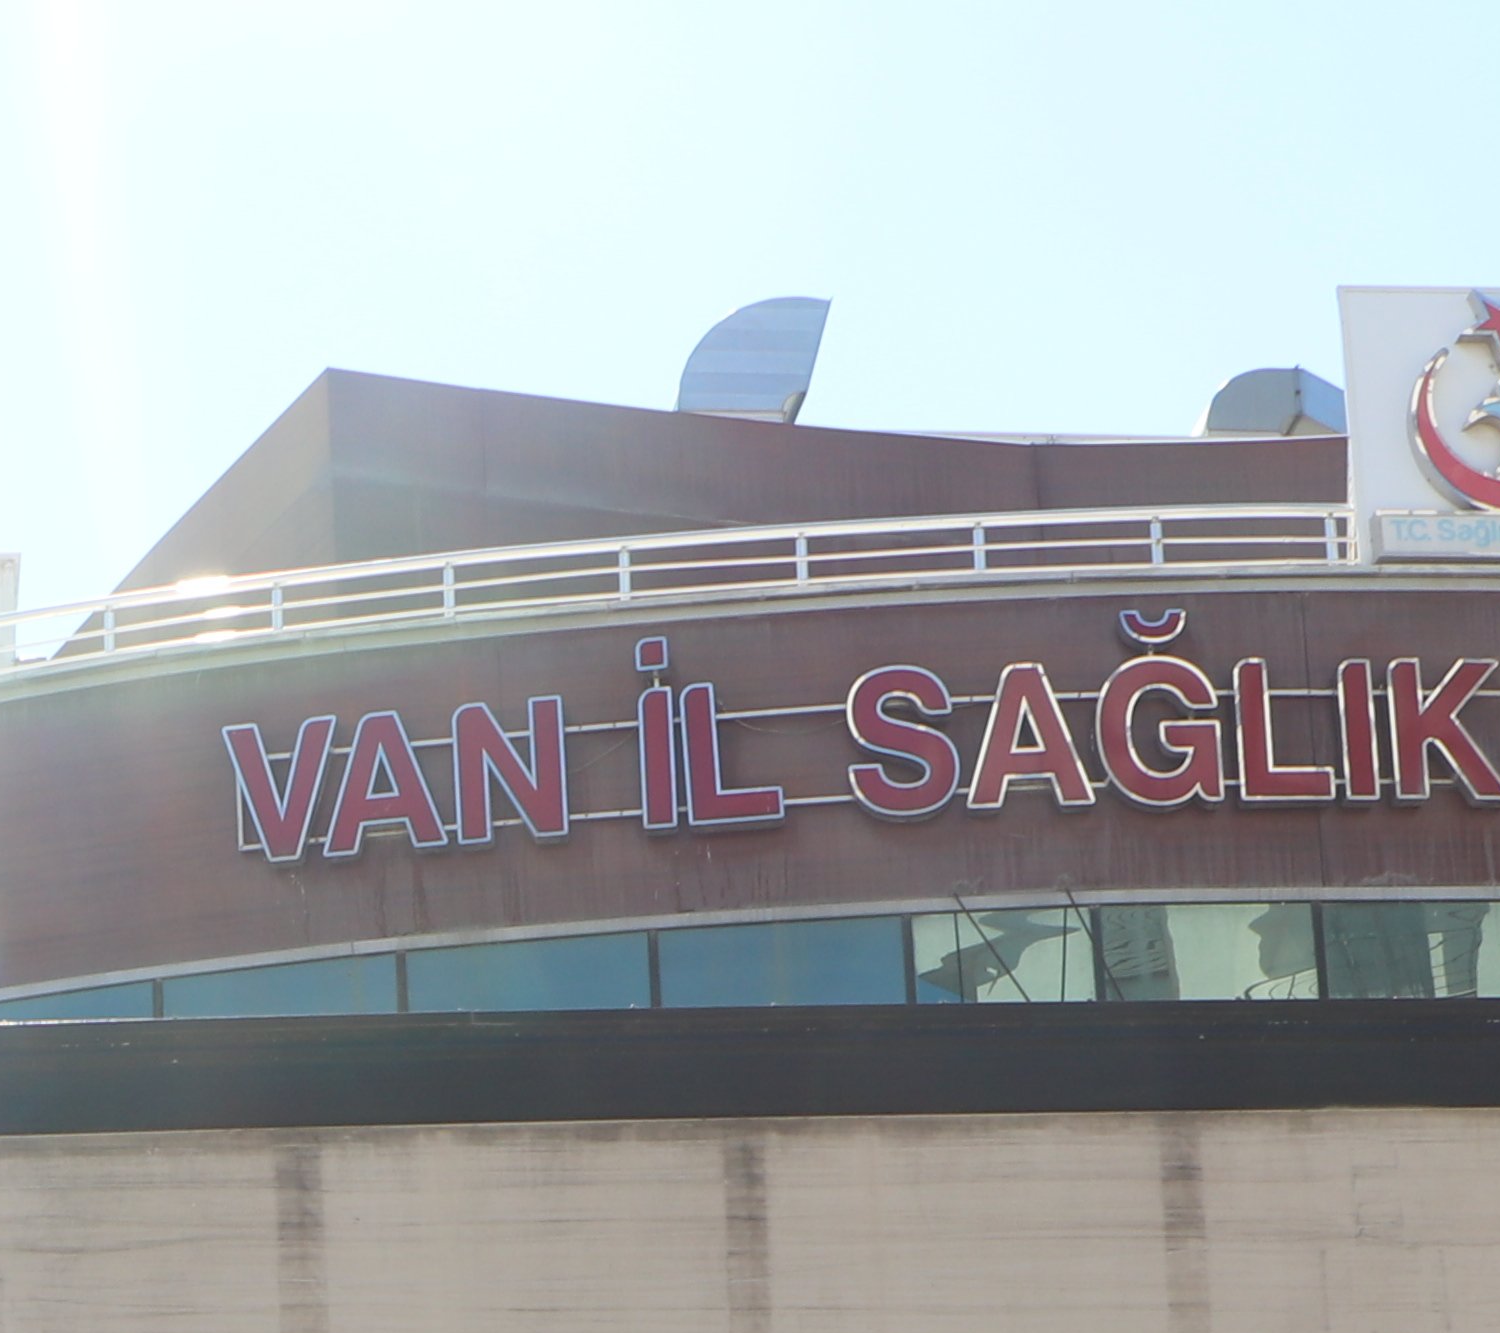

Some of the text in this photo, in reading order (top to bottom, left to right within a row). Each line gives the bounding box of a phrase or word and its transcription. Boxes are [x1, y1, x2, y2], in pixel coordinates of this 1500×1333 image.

[1391, 519, 1430, 542] T.C.
[222, 694, 568, 864] VAN
[634, 635, 787, 831] İL
